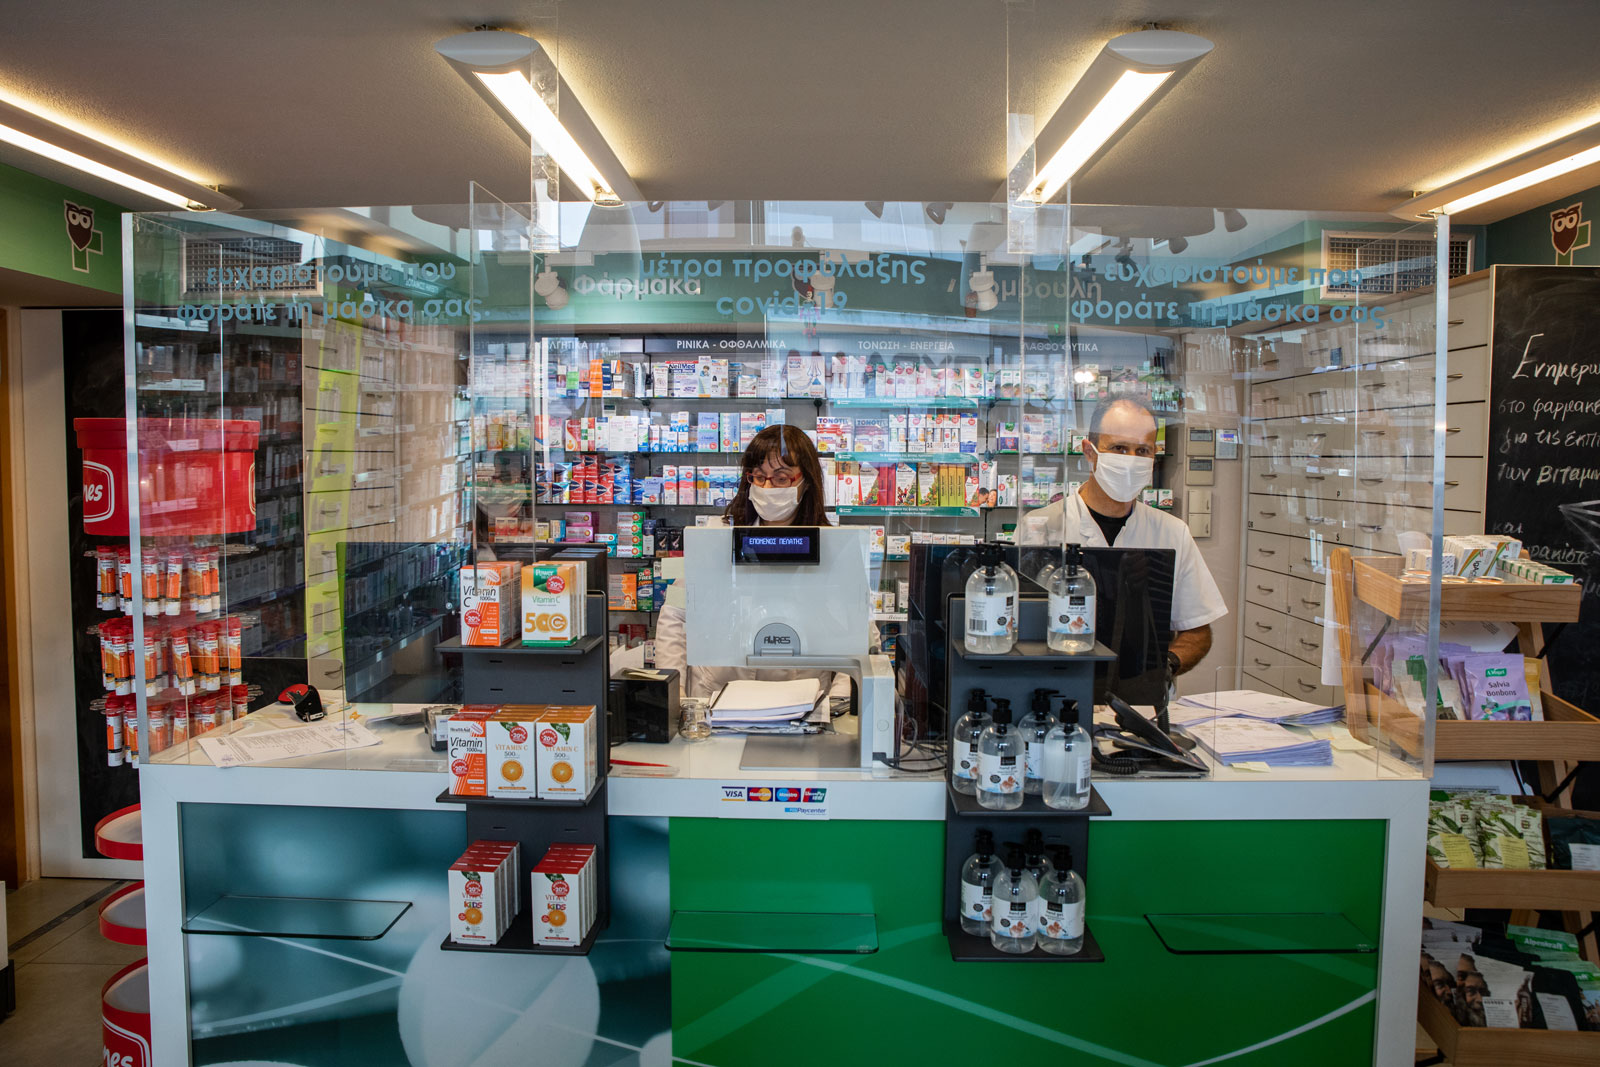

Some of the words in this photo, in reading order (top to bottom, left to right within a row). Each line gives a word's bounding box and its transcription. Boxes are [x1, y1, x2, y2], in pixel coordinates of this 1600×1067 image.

[206, 261, 393, 287] ευχαριστούμε
[400, 261, 457, 281] που
[638, 252, 722, 282] μέτρα
[732, 250, 927, 285] προφύλαξης
[1104, 259, 1299, 289] ευχαριστούμε
[1309, 266, 1363, 287] που
[573, 271, 701, 296] Φάρμακα
[176, 298, 277, 323] φοράτε
[285, 301, 313, 325] τη
[322, 295, 414, 323] μάσκα
[422, 298, 490, 322] σας.
[716, 290, 848, 316] covid-19
[1071, 293, 1179, 324] φοράτε
[1188, 301, 1217, 328] τη
[1226, 297, 1320, 327] μάσκα
[1329, 301, 1393, 330] σας.
[676, 339, 710, 349] ΡΙΝΙΚΑ
[719, 339, 786, 349] ΟΦΘΑΛΜΙΚΑ
[857, 340, 900, 350] ΤΟΝΩΣΗ
[910, 341, 955, 350] ΕΝΕΡΓΕΙΑ
[463, 597, 471, 608] C
[1488, 681, 1510, 689] Salvia
[450, 737, 483, 748] Vitamin
[450, 748, 458, 758] C
